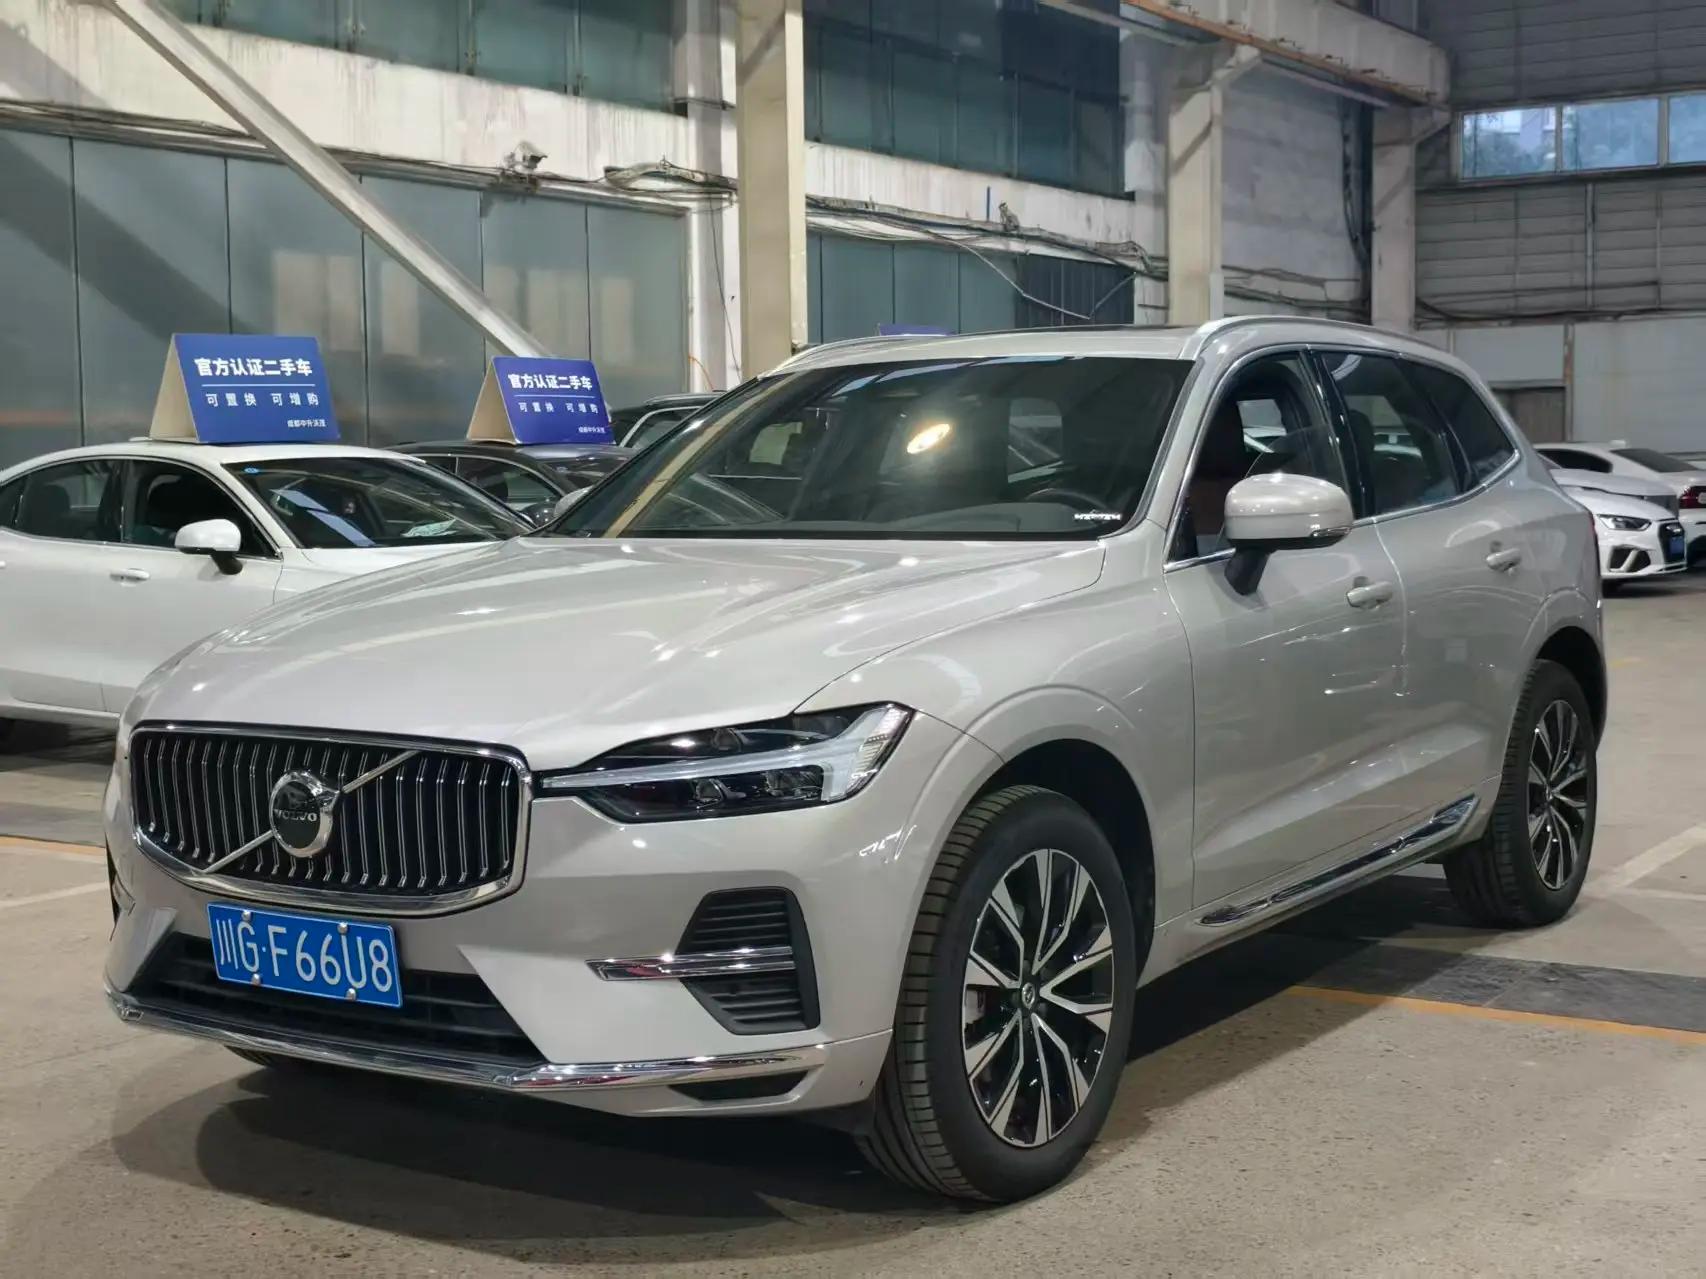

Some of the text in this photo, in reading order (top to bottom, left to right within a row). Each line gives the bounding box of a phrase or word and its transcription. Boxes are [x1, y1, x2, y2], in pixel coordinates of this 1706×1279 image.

[194, 358, 313, 376] 官方认证二手车
[508, 373, 592, 391] 官方认证二手车
[206, 392, 319, 406] 可置换 可增购
[273, 809, 318, 822] VOLVO
